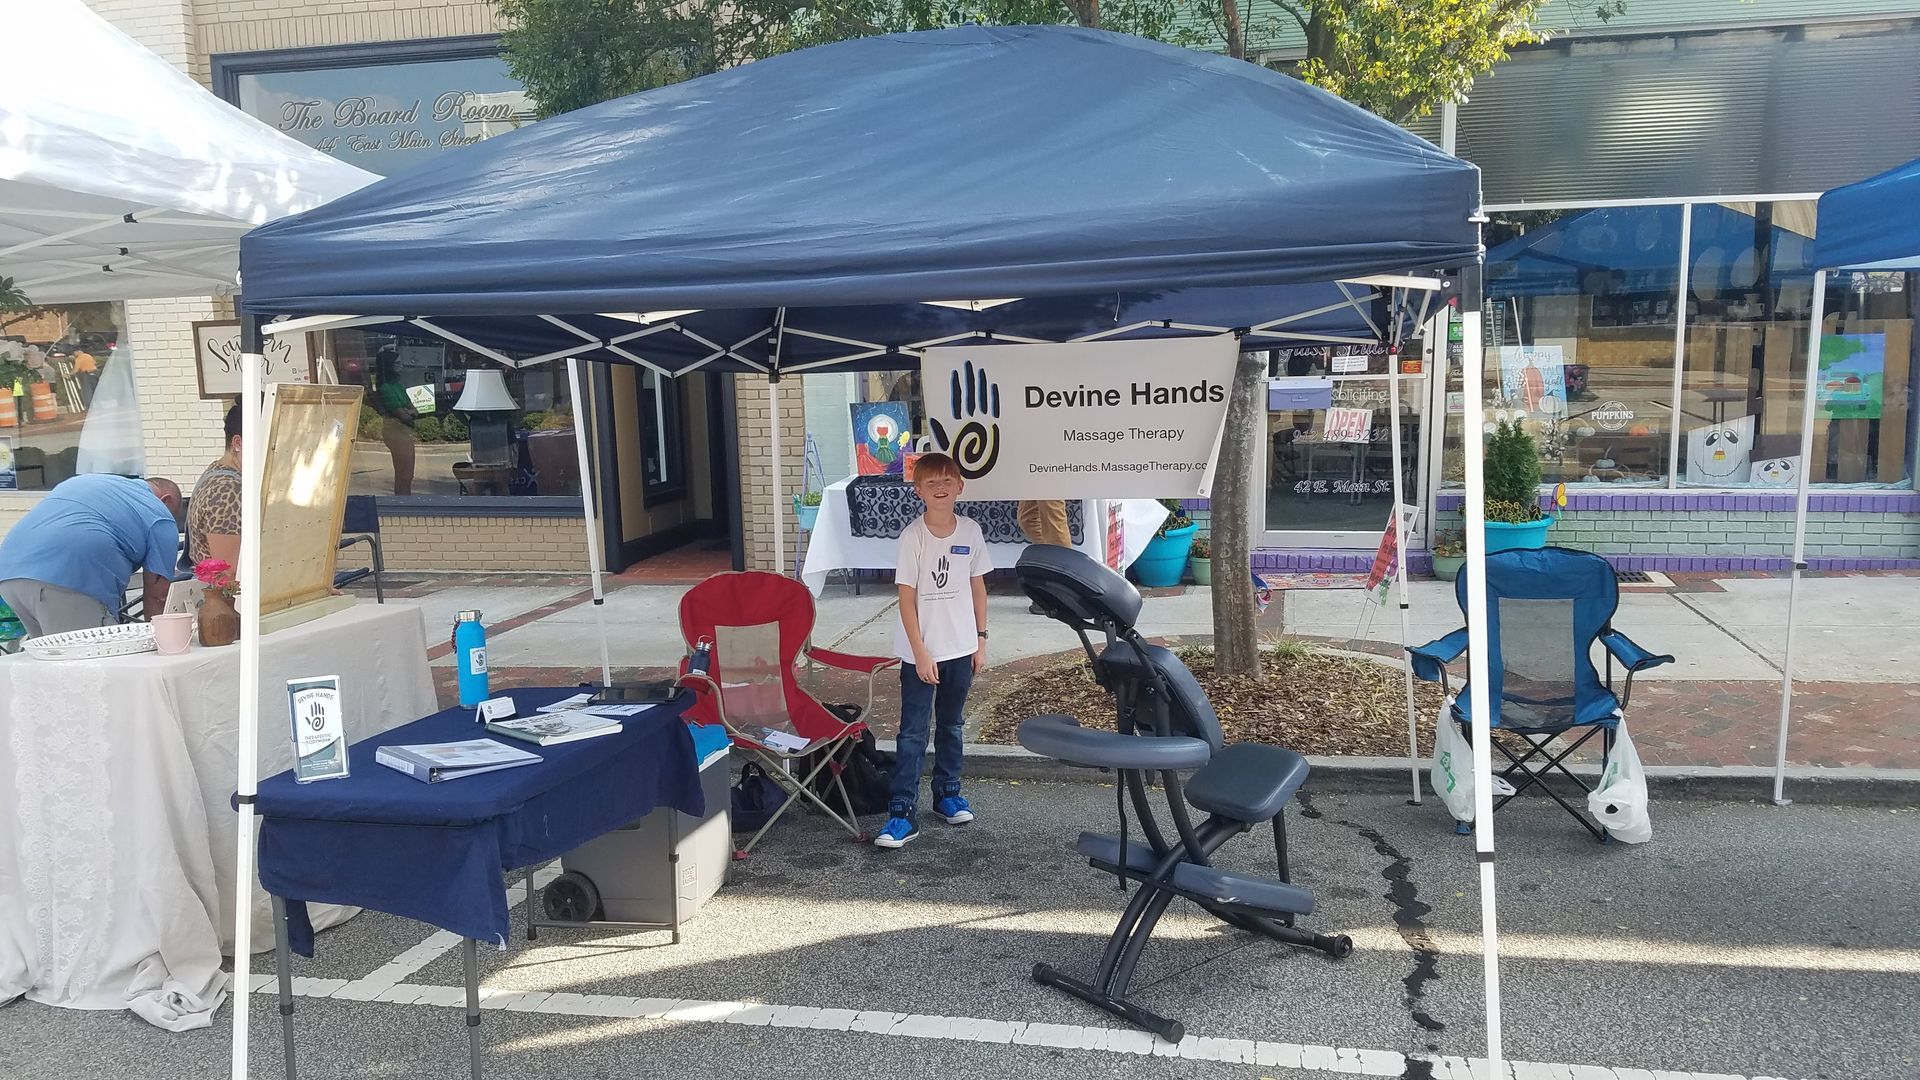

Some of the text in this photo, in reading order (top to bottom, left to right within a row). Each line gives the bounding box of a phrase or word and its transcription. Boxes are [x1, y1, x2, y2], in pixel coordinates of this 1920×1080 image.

[279, 90, 513, 131] The Board Room
[346, 134, 383, 154] East
[389, 130, 433, 150] Main
[438, 128, 482, 151] Street
[1024, 380, 1225, 409] Devine Hands
[1591, 411, 1634, 420] PUMPKINS
[1329, 411, 1368, 438] OPEN
[1063, 427, 1185, 443] Massage Therapy
[1029, 461, 1208, 474] DevineHands.MassageTherapy.co
[1293, 480, 1311, 493] 42
[1332, 479, 1371, 493] Main
[315, 691, 334, 701] HANDS
